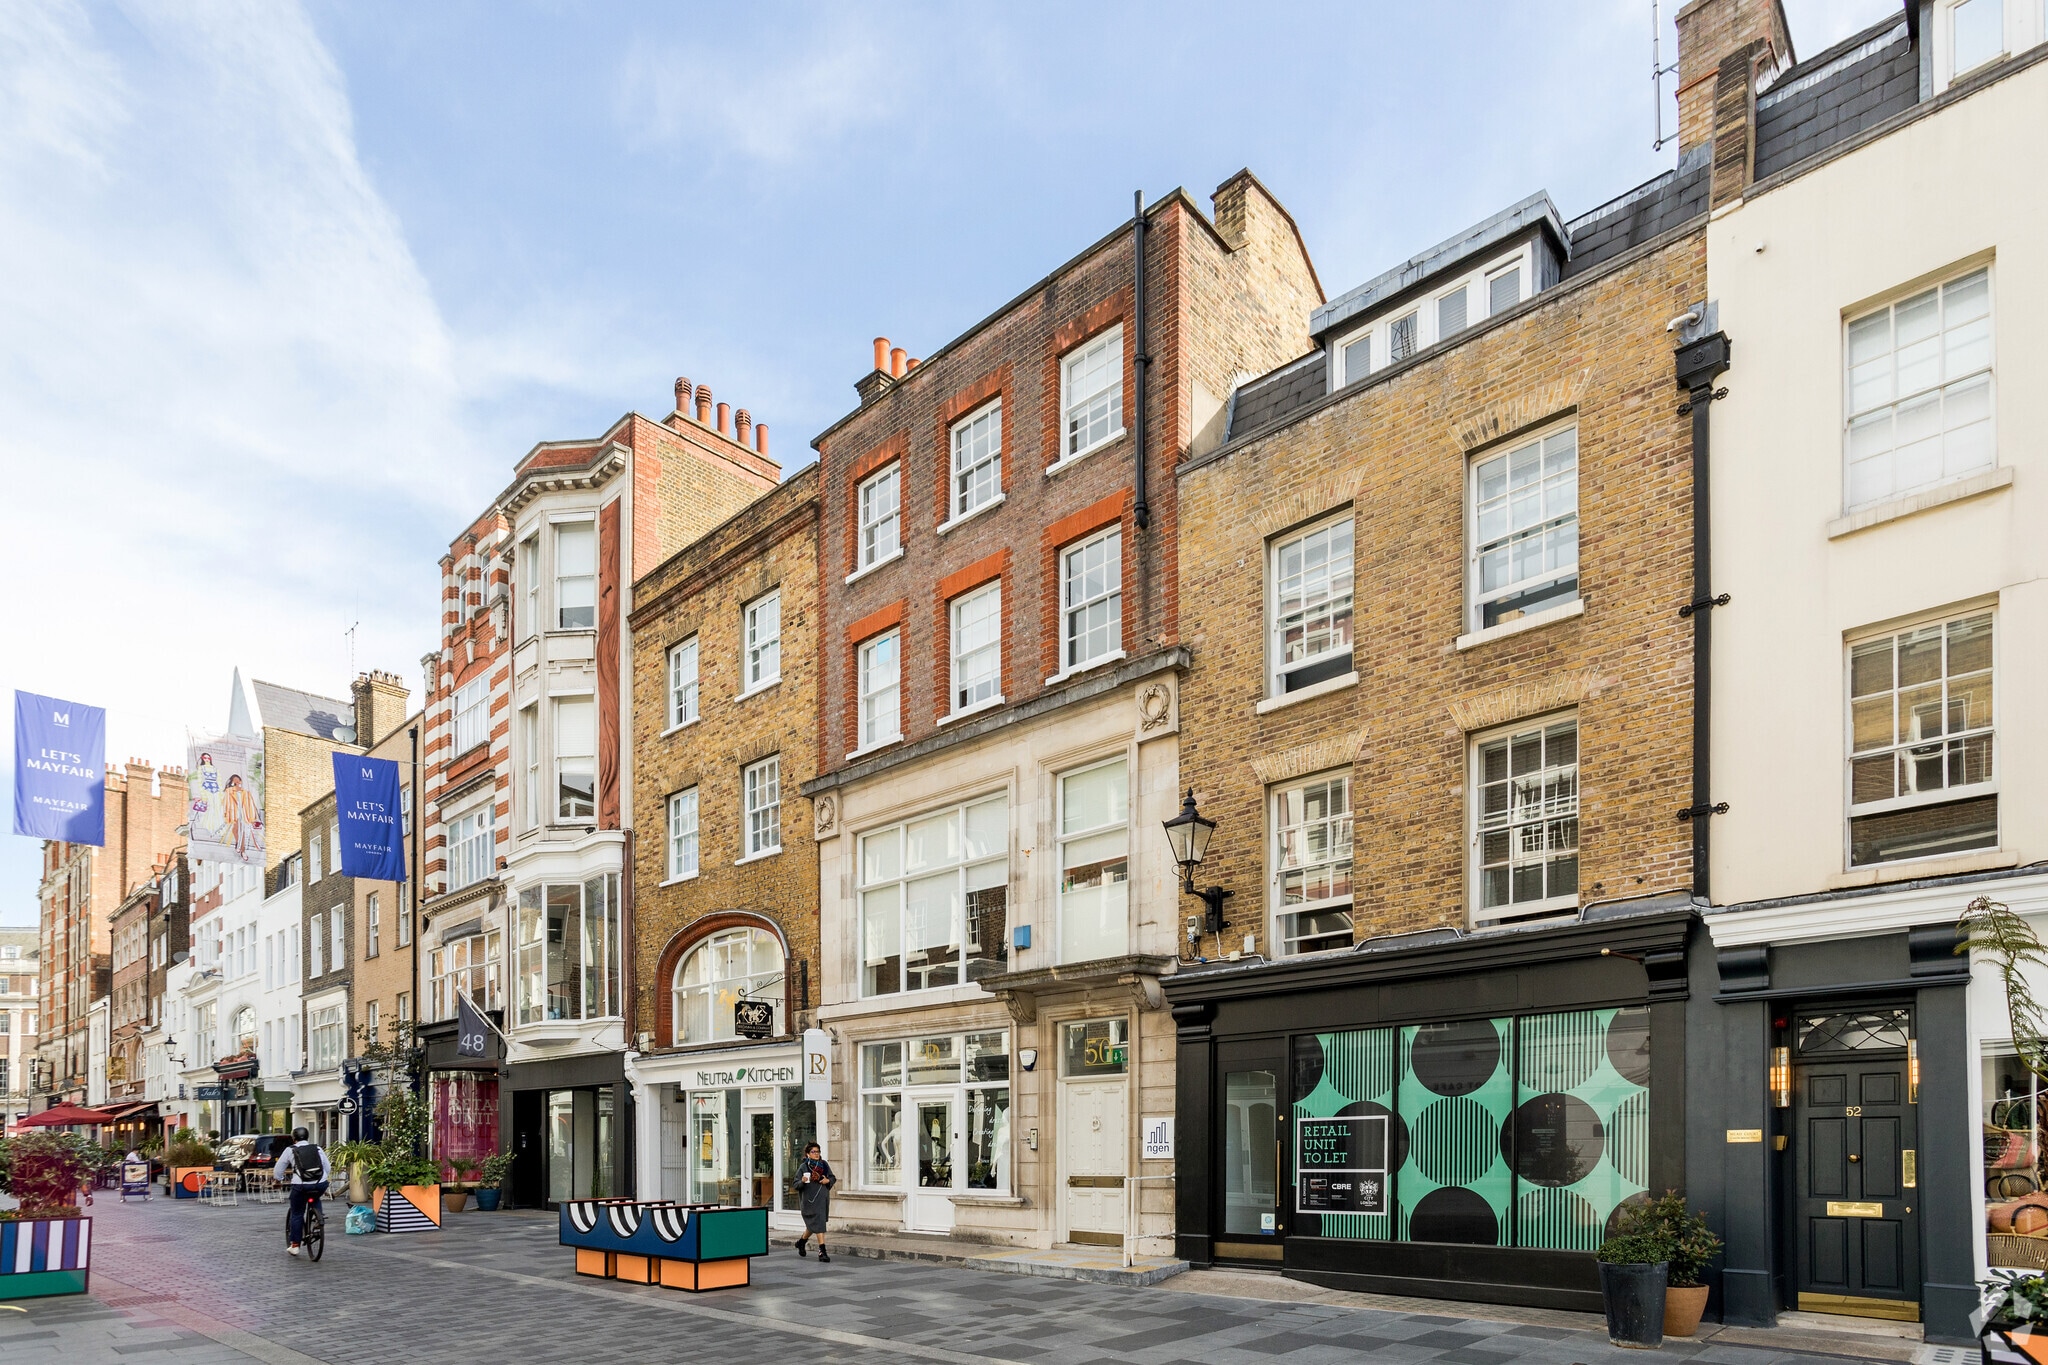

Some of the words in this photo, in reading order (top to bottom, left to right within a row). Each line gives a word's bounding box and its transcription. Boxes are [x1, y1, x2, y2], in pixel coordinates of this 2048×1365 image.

[54, 711, 69, 725] M
[41, 748, 81, 764] LET'S
[27, 758, 94, 779] MAYFAIR
[361, 767, 373, 779] M
[33, 796, 88, 811] MAYFAIR
[356, 801, 385, 812] LET'S
[347, 811, 394, 825] MAYFAIR
[354, 842, 392, 853] MAYFAIR
[461, 1033, 484, 1051] 48
[1086, 1038, 1113, 1065] 50
[697, 1071, 734, 1086] NEUTRA
[747, 1067, 794, 1083] KITCHEN
[757, 1091, 767, 1101] 49
[1846, 1106, 1862, 1117] 52
[451, 1112, 493, 1125] UNIT
[1303, 1125, 1351, 1137] RETAIL
[1146, 1145, 1169, 1154] ngen
[1303, 1139, 1337, 1150] UNIT
[1303, 1152, 1321, 1164] TO
[1324, 1152, 1347, 1164] LET
